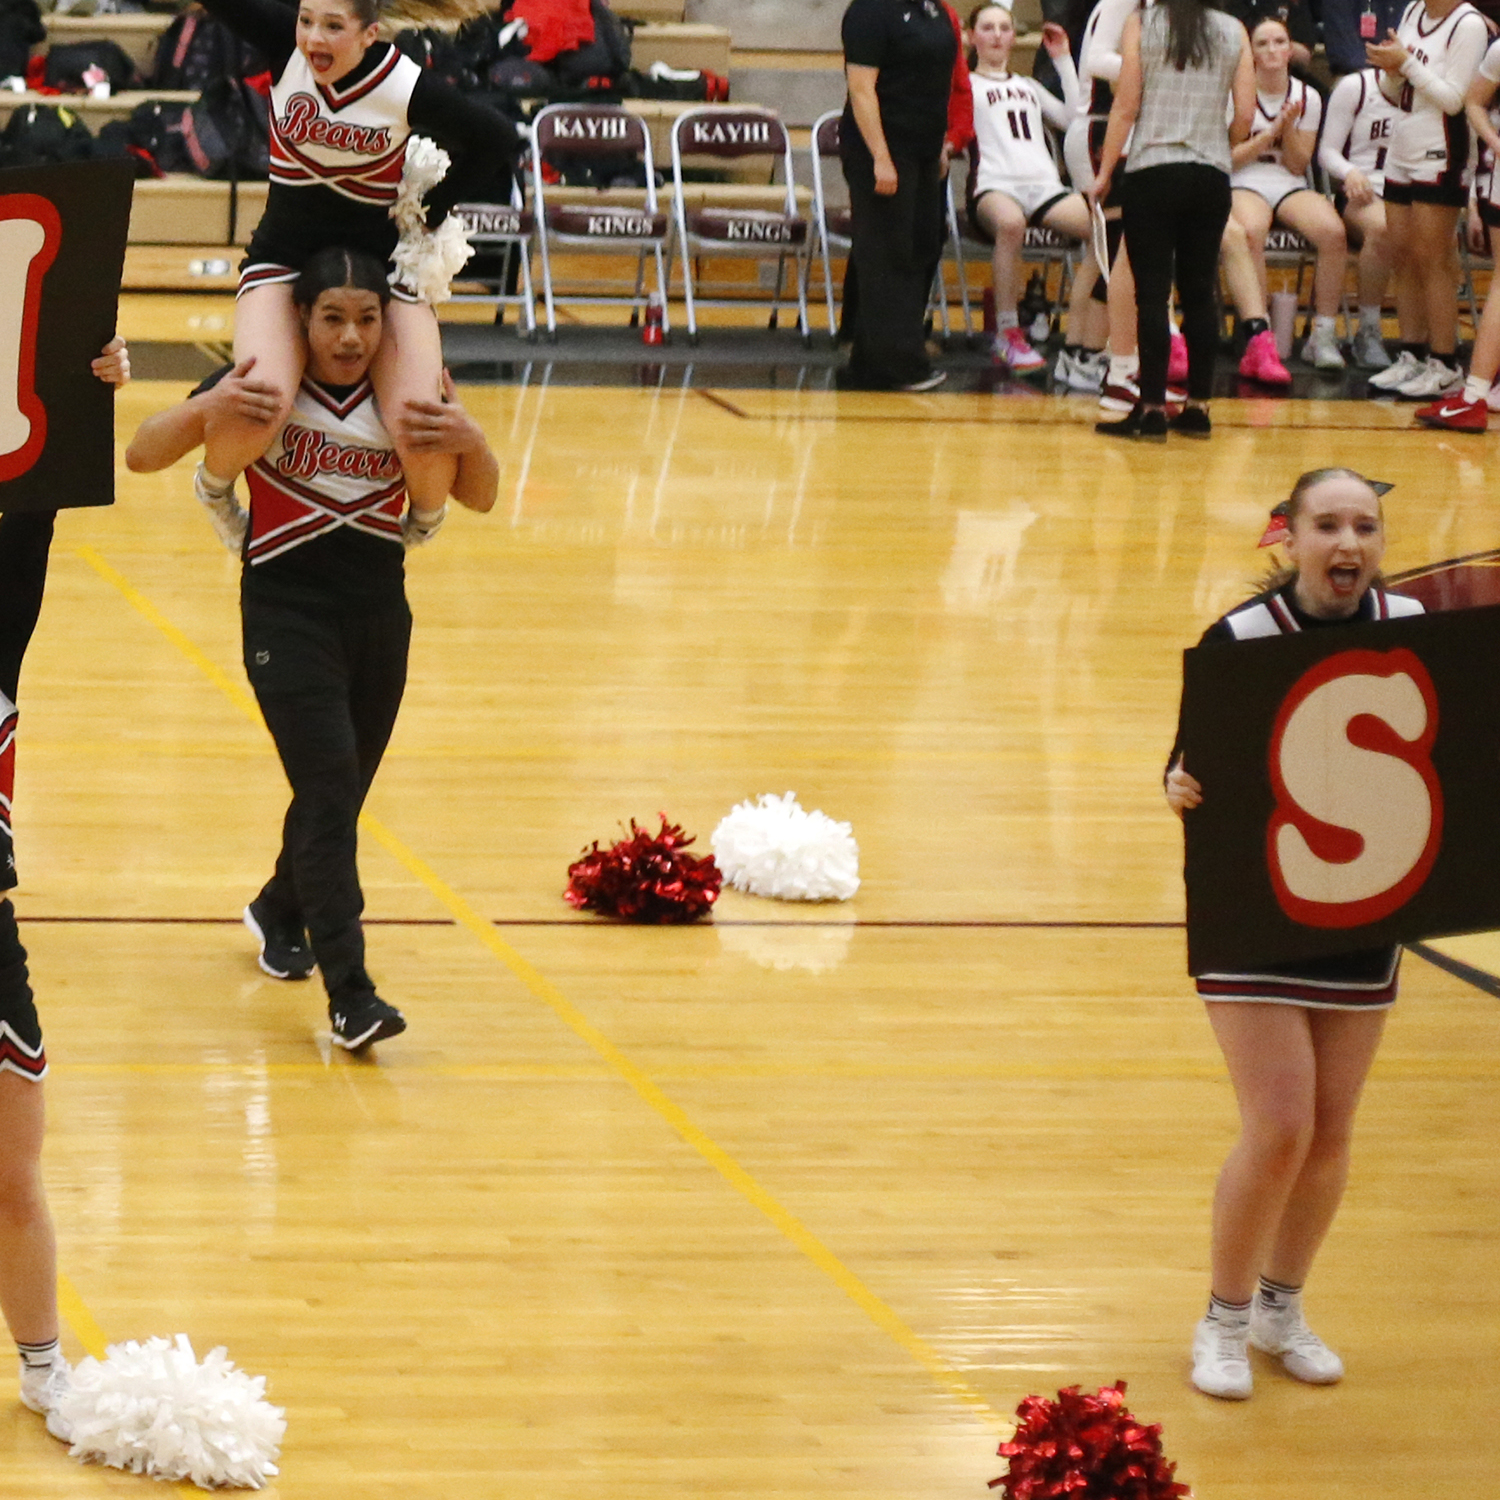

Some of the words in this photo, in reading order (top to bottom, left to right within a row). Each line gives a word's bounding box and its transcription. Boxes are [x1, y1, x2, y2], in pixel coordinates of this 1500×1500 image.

[278, 93, 392, 155] Bears
[553, 116, 628, 139] KAYHI
[693, 121, 770, 143] KAYHI
[1006, 110, 1032, 141] 11
[588, 215, 653, 236] KINGS
[727, 220, 792, 242] KINGS
[1267, 648, 1445, 928] S
